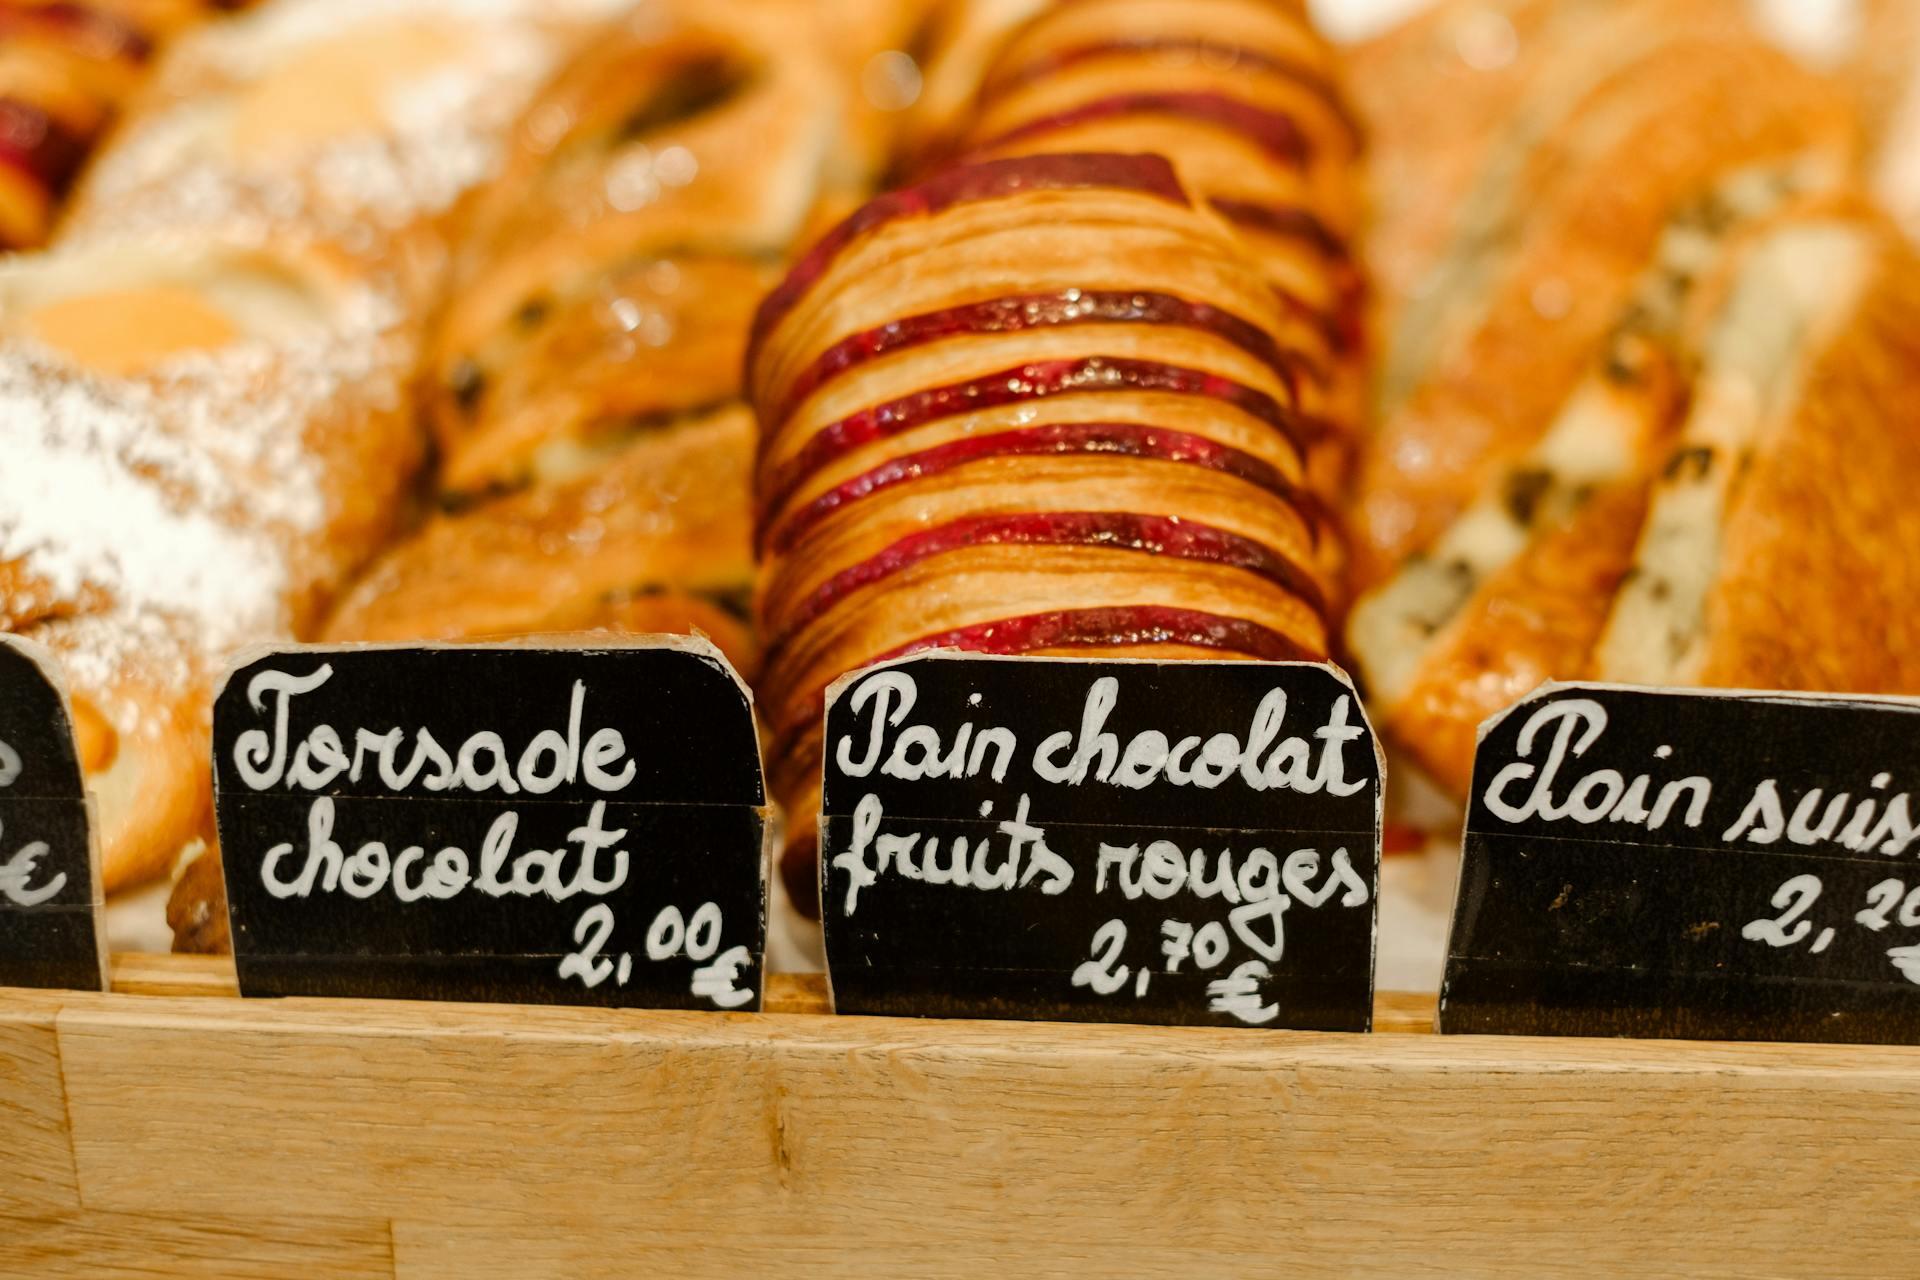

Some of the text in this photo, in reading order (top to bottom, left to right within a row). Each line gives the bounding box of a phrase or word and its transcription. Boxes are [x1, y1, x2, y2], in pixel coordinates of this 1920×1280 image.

[233, 662, 637, 794] Torsade
[834, 670, 1368, 797] Pain chocolat
[1483, 699, 1920, 857] Pain suis
[260, 797, 630, 902] chocolat
[832, 793, 1369, 962] fruits rouges
